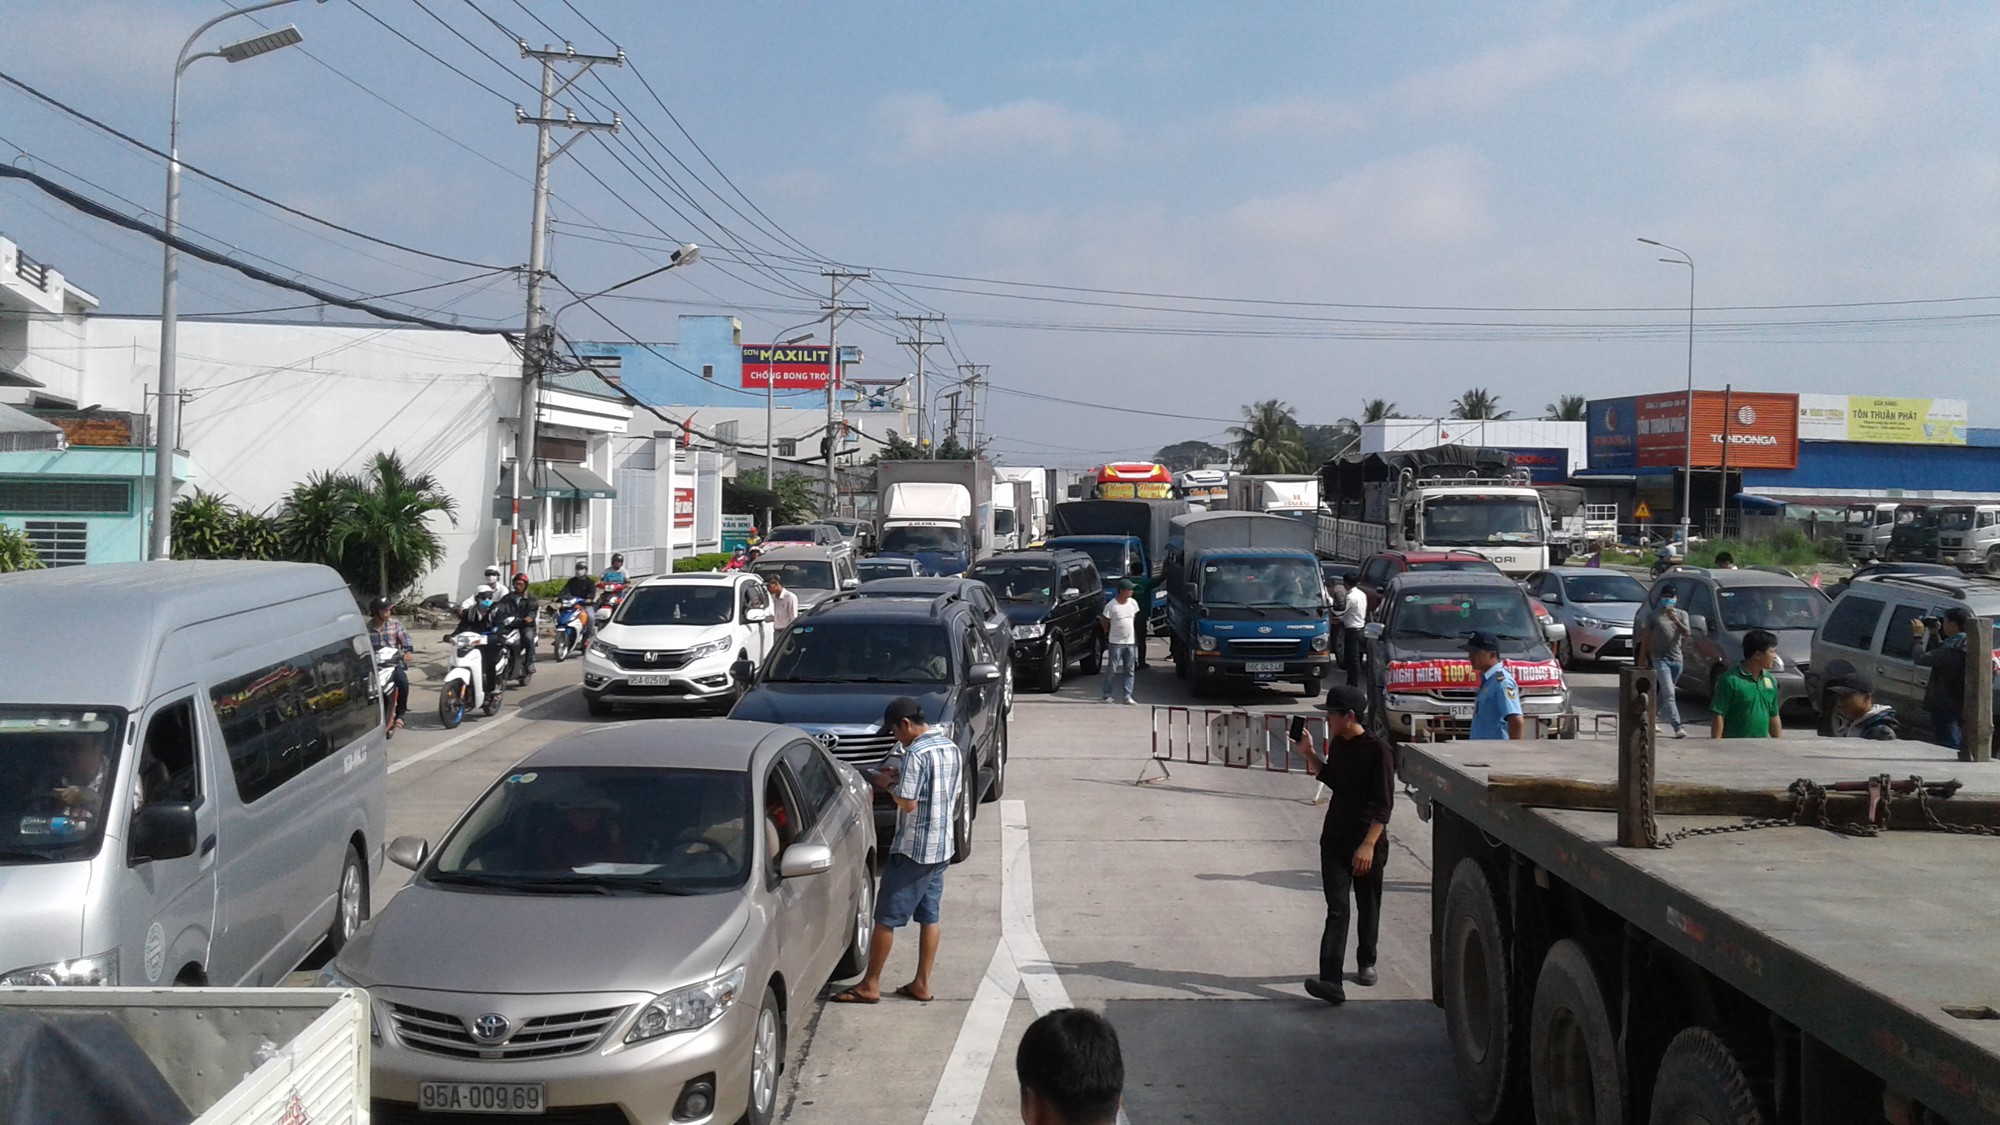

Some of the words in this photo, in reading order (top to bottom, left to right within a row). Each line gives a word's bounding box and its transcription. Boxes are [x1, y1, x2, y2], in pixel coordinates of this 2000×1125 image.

[760, 349, 829, 362] MAXILIT
[783, 371, 808, 380] BONG
[1710, 433, 1778, 446] TONDONGA
[1444, 664, 1477, 683] 100%
